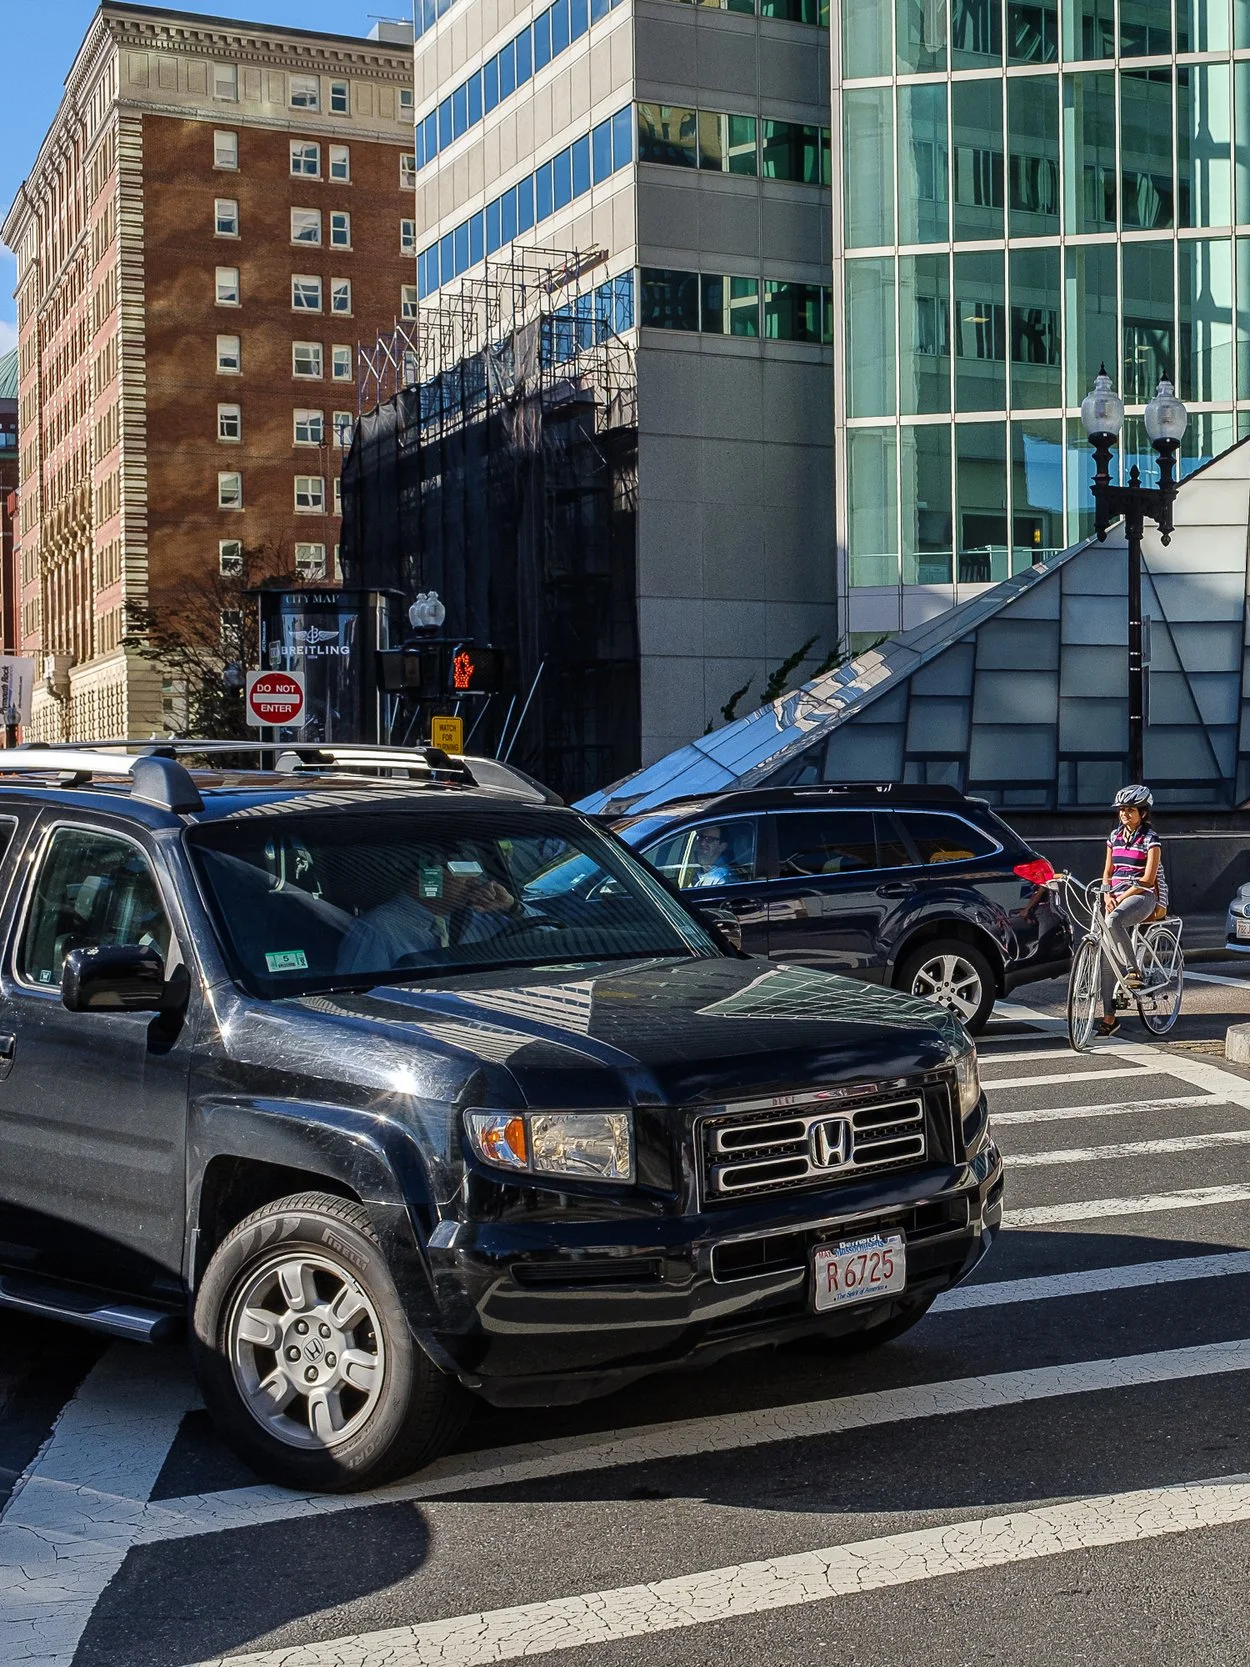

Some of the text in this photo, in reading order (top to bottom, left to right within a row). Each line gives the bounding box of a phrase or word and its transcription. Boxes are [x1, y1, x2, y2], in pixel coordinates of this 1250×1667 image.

[286, 594, 340, 604] CITY MAP
[280, 645, 351, 656] BREITLING
[256, 684, 296, 693] DO NOT
[260, 704, 292, 713] ENTER
[439, 723, 457, 732] WATCH
[441, 733, 454, 742] FOR
[321, 1227, 371, 1271] PIRELLI
[827, 1248, 894, 1293] R 6725
[846, 1289, 859, 1299] Spirit
[859, 1288, 865, 1296] of
[864, 1284, 884, 1294] America
